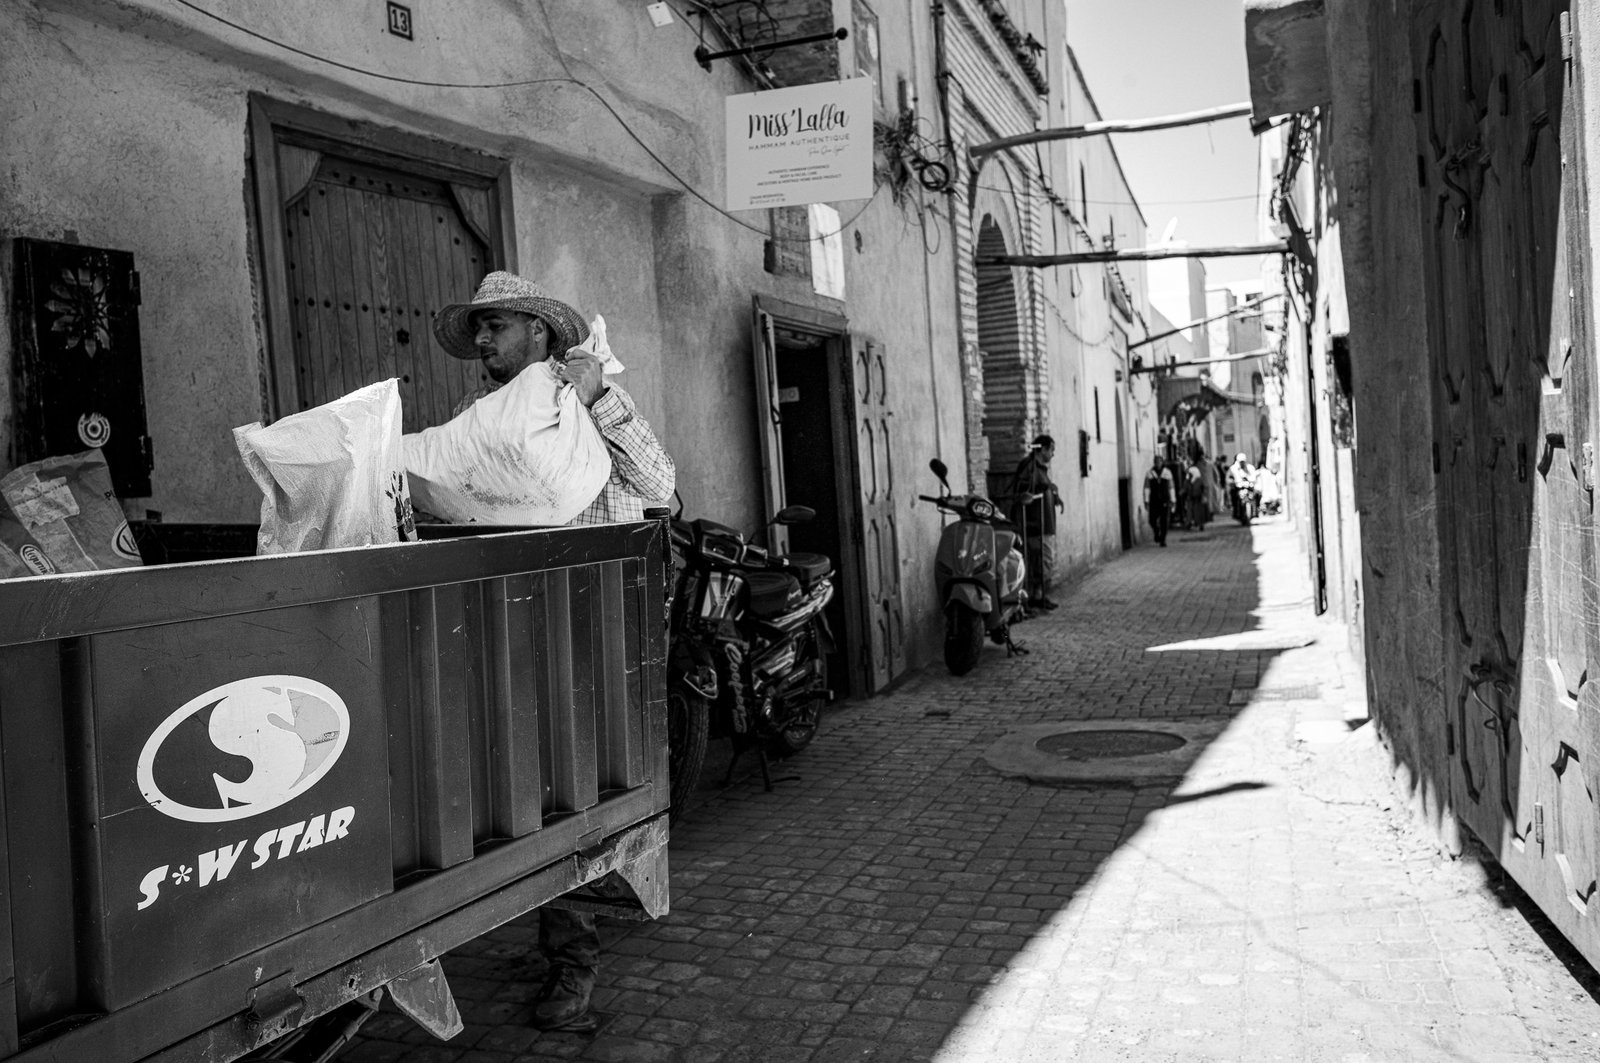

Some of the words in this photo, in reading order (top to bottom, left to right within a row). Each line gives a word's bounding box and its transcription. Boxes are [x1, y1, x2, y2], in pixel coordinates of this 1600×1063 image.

[391, 8, 408, 33] 13
[748, 140, 787, 151] HAMMAM
[790, 132, 851, 147] AUTHENTIQUE
[251, 805, 356, 870] STAR
